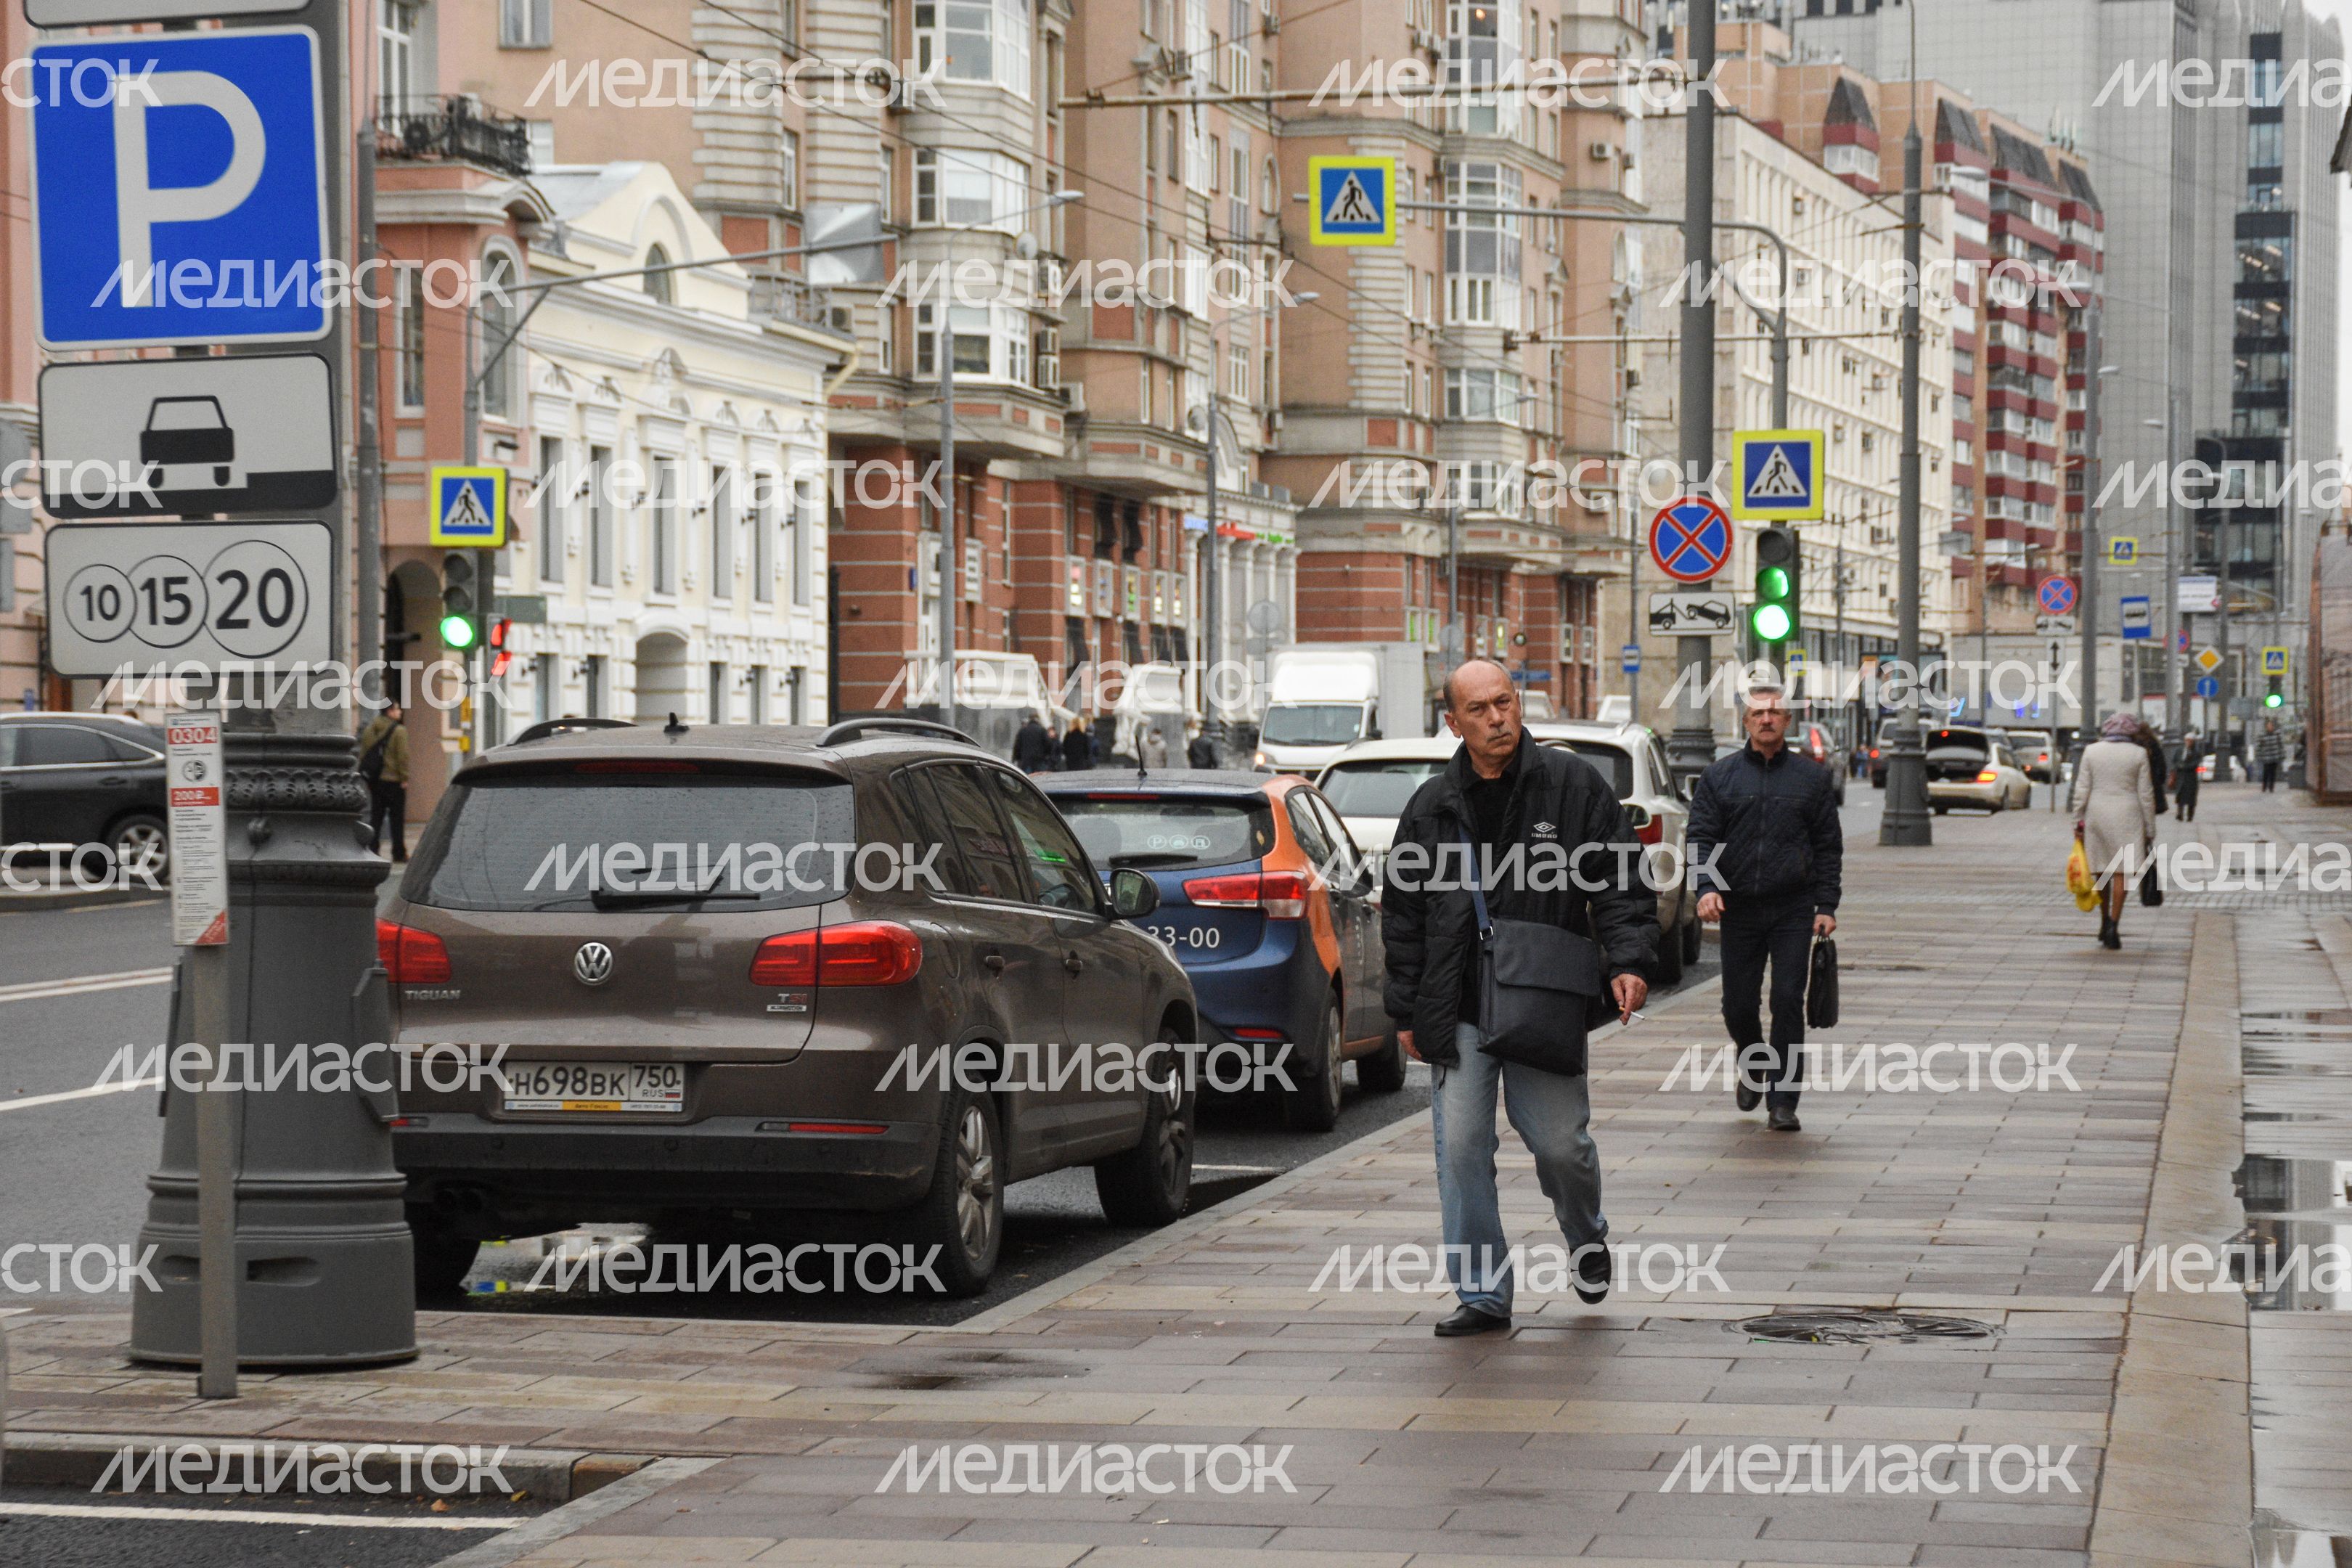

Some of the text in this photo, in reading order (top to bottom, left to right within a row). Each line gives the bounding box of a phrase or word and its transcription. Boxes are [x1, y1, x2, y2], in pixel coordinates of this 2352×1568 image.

[112, 70, 266, 309] P
[79, 568, 294, 630] 10 15 20
[172, 727, 217, 744] 0304
[405, 989, 461, 1000] TIGUAN
[634, 1065, 677, 1088] 750
[642, 1089, 664, 1098] RUS
